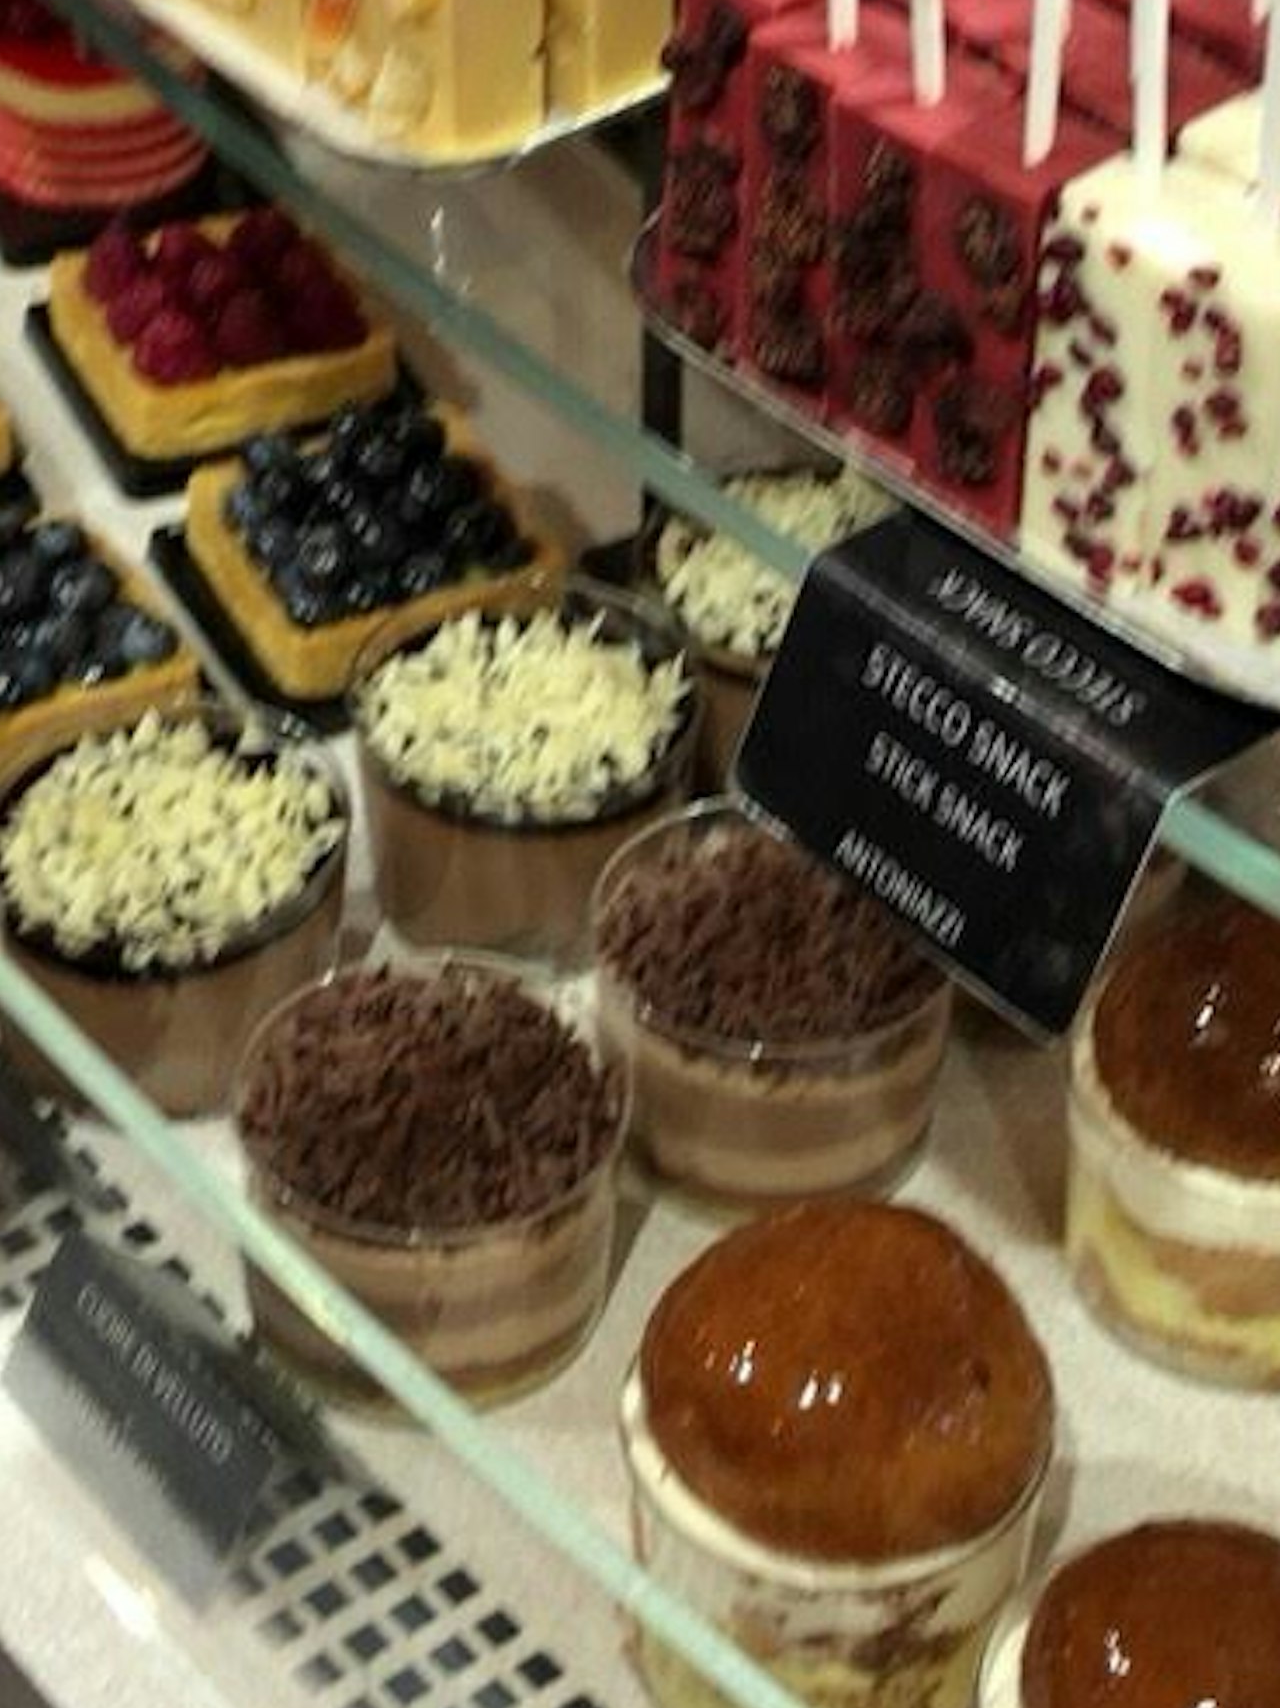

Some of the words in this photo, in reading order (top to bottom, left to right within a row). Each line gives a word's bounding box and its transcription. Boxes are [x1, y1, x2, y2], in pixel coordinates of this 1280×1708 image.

[860, 641, 972, 749] STECCO
[968, 718, 1071, 819] SNACK
[865, 731, 938, 811] STICK
[931, 773, 1024, 872] SNACK
